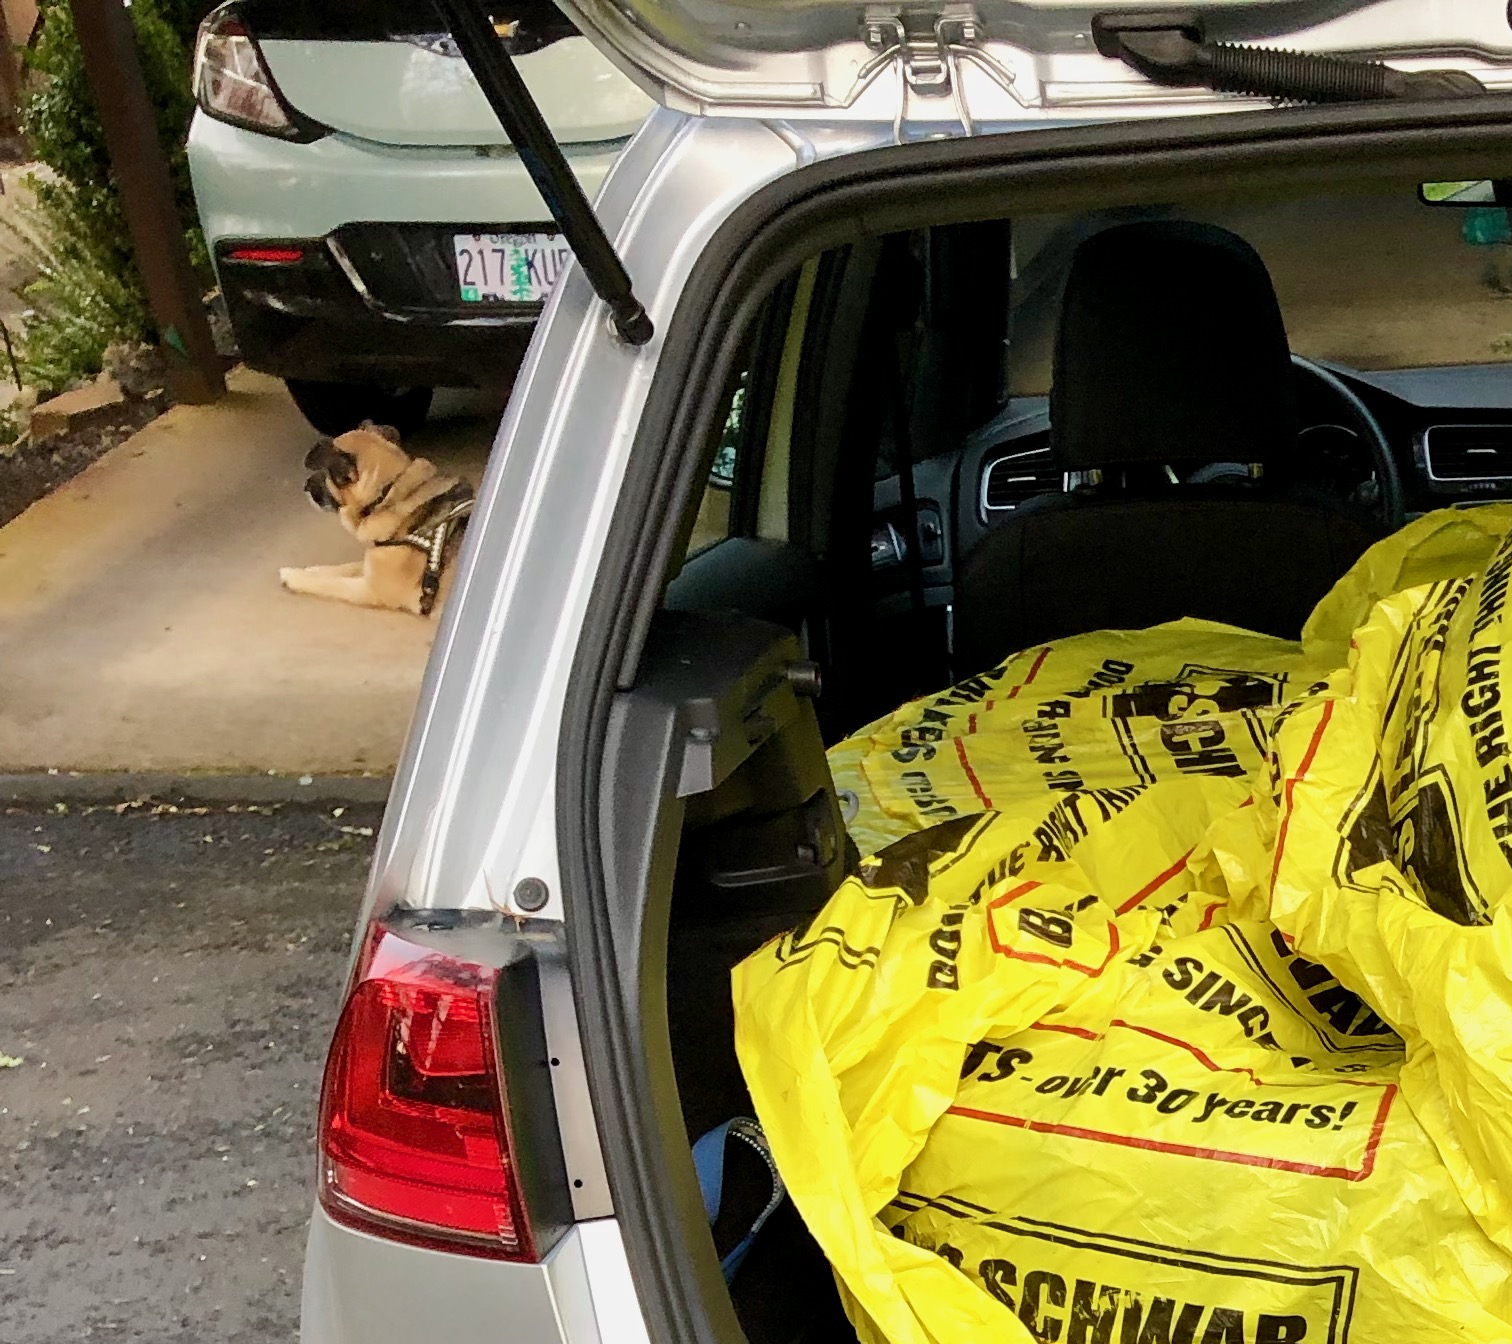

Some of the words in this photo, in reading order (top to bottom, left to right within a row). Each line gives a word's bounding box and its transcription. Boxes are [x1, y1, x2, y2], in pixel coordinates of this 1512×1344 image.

[459, 248, 506, 286] 217
[1460, 640, 1512, 768] RIGHT
[1126, 1068, 1201, 1115] 30
[1191, 1090, 1359, 1132] years!
